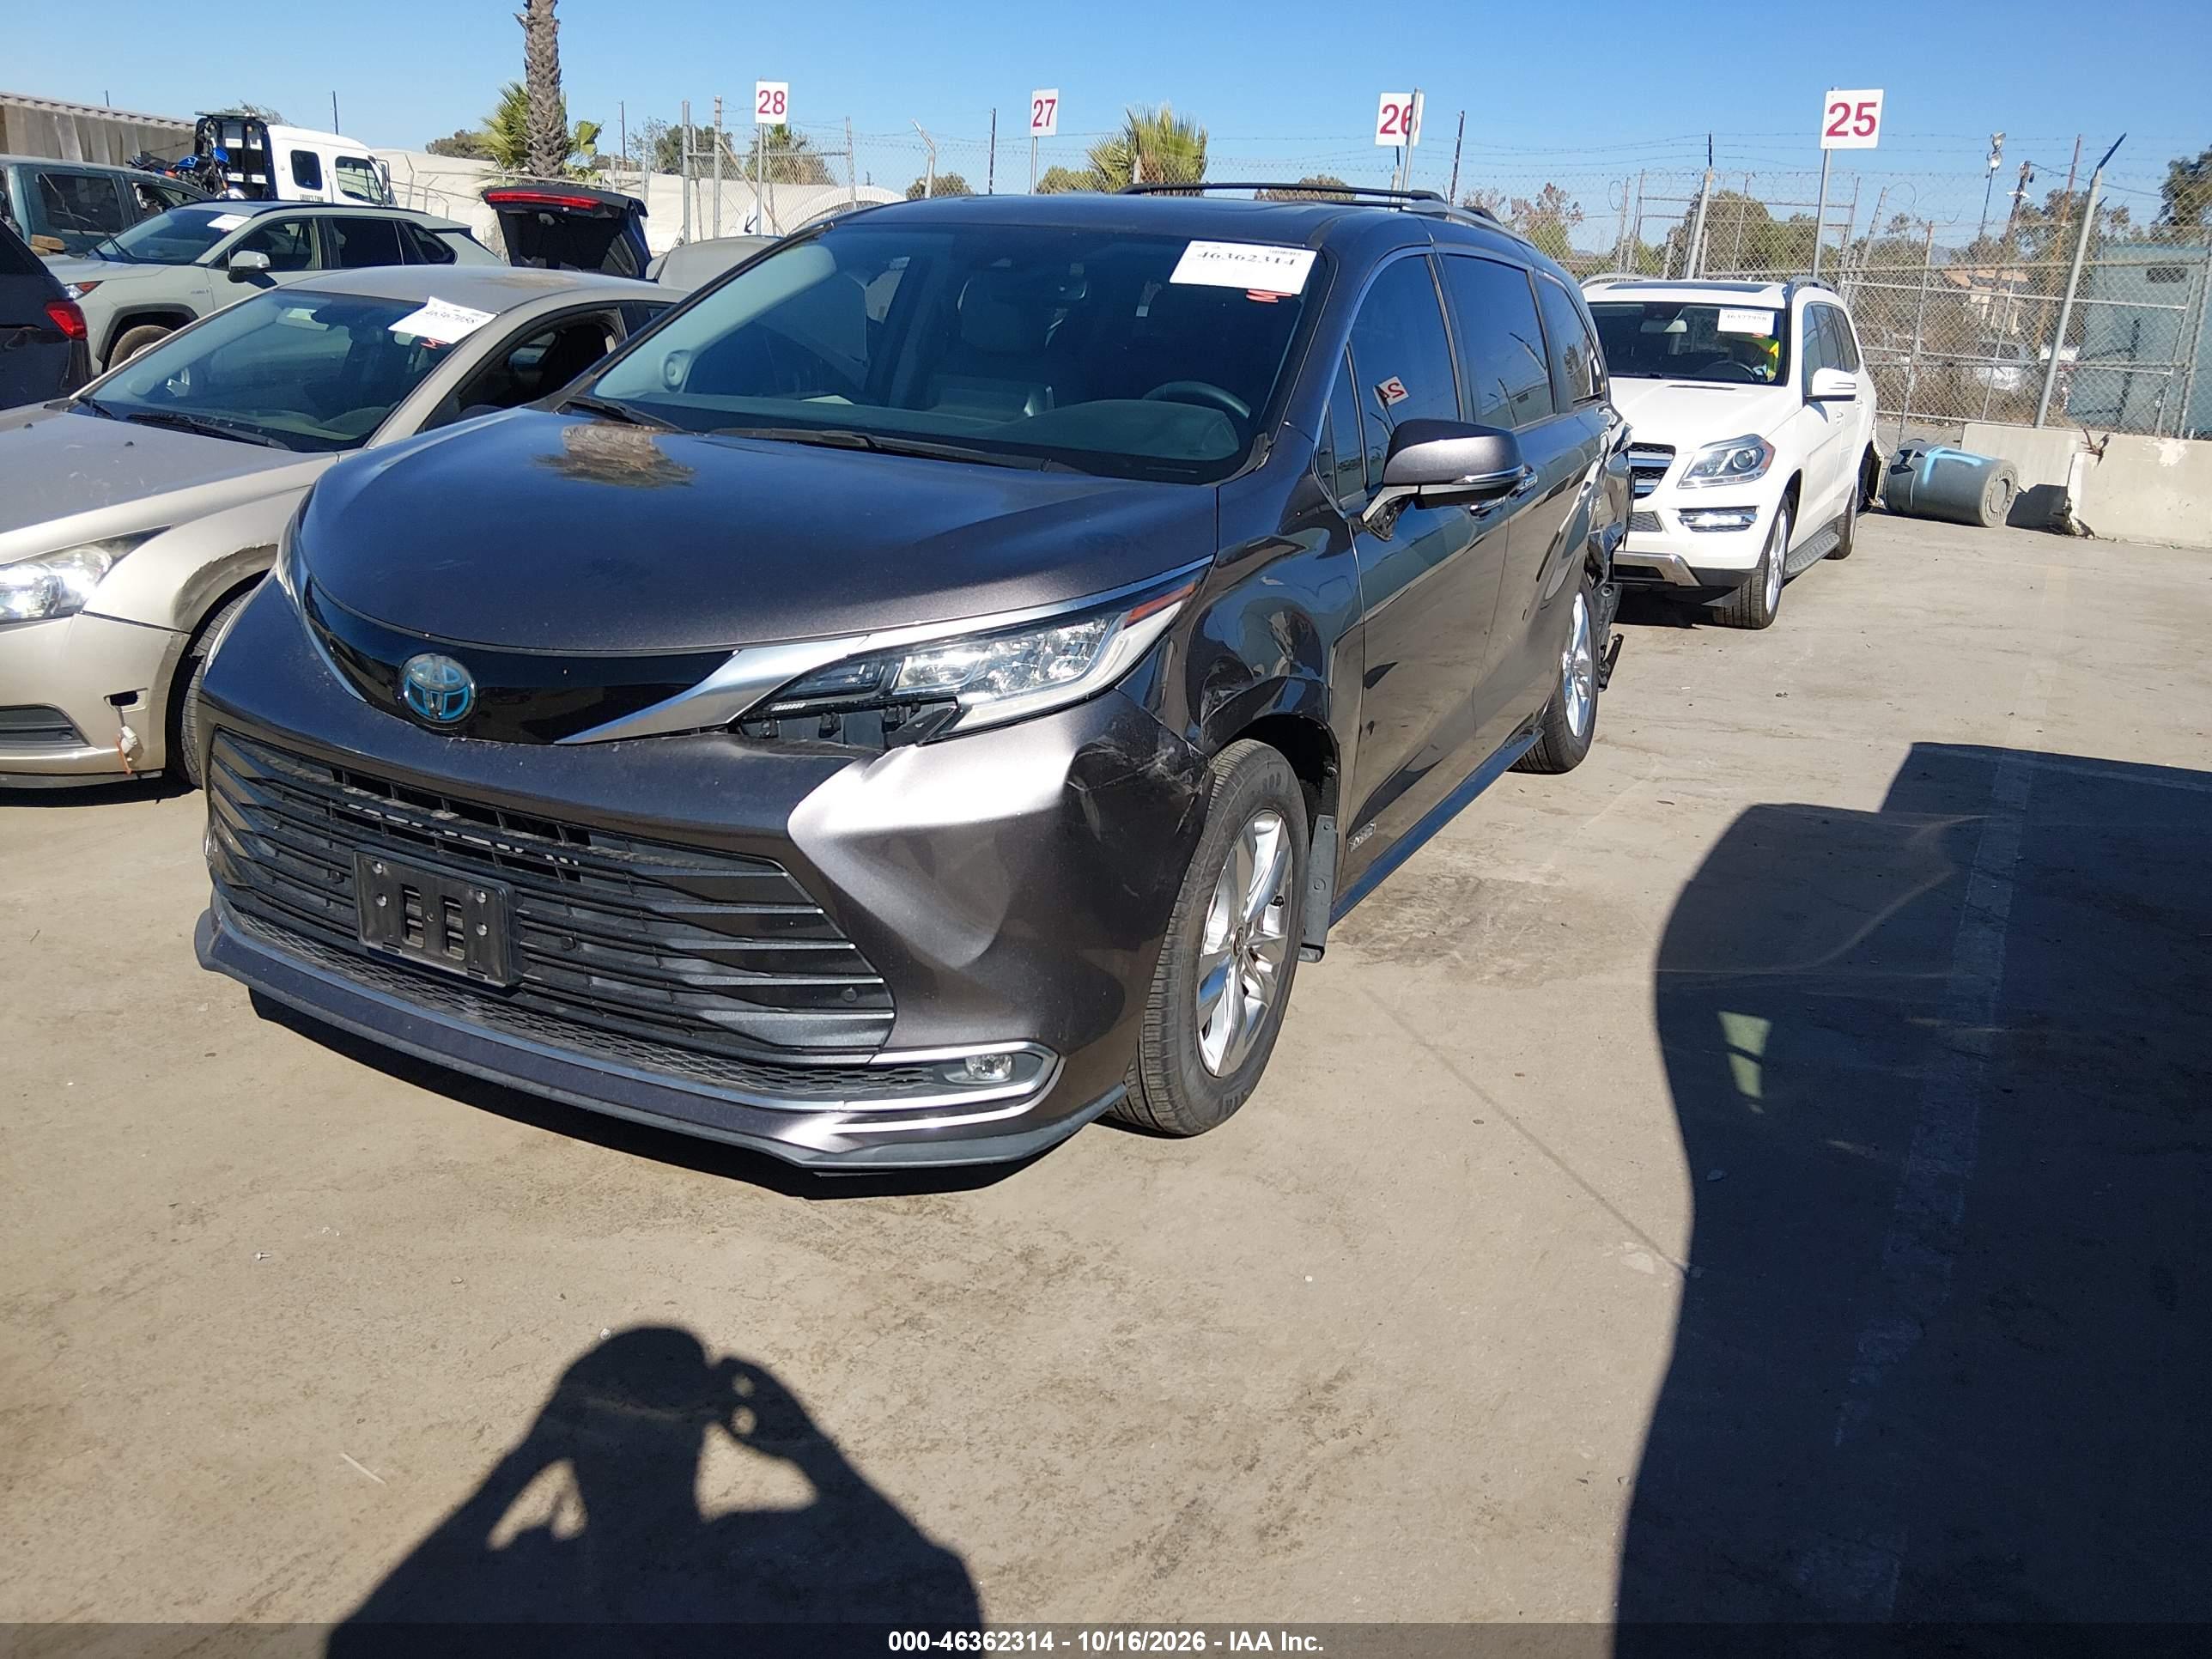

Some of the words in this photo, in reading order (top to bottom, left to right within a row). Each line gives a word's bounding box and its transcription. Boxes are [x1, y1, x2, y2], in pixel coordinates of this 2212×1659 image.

[758, 91, 785, 113] 28
[1033, 99, 1056, 128] 27
[1380, 104, 1418, 137] 26
[1826, 102, 1877, 137] 25
